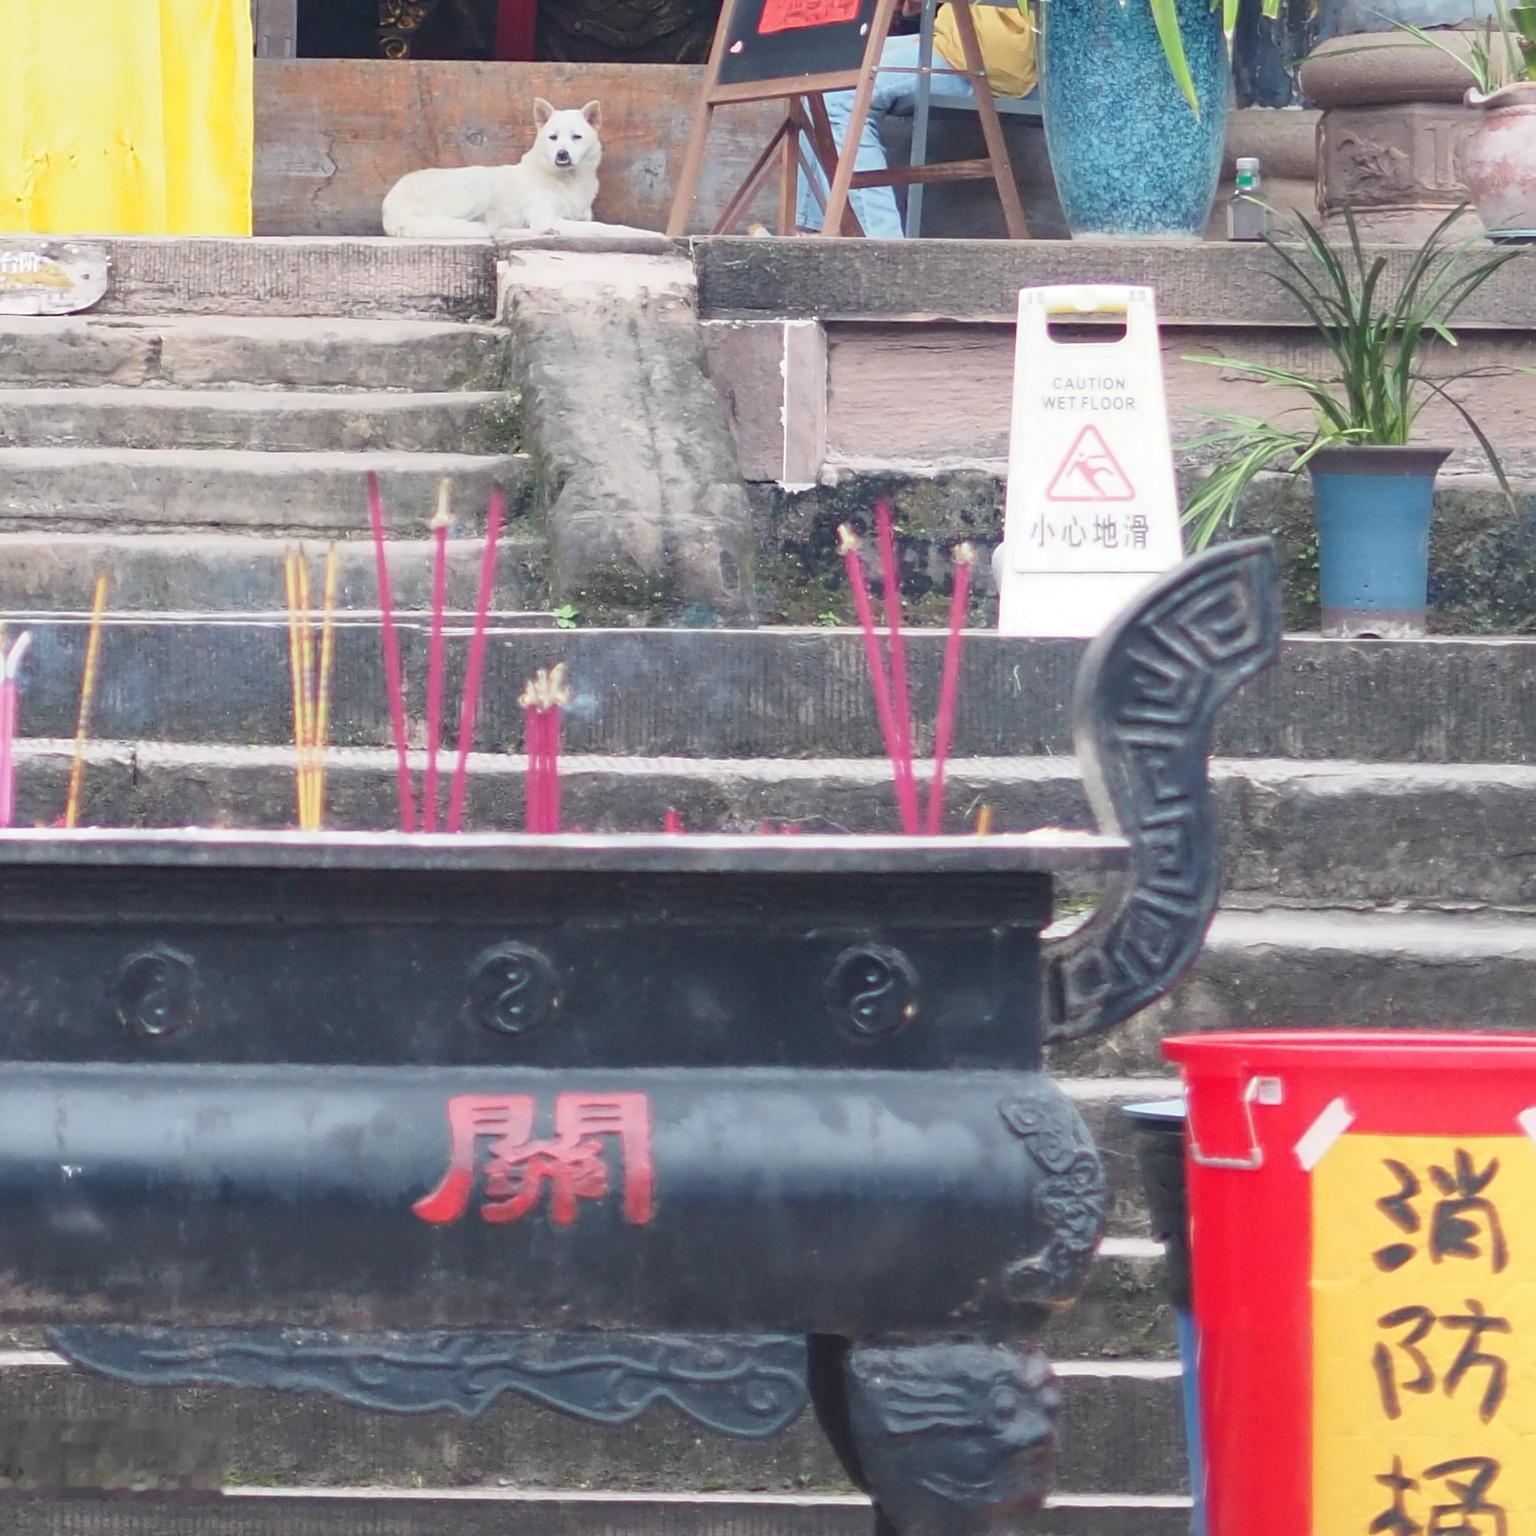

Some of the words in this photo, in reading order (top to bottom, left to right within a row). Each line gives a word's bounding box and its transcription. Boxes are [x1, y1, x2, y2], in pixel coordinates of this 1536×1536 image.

[1052, 376, 1126, 390] CAUTION
[1042, 396, 1075, 410] WET
[1081, 396, 1135, 410] FLOOR
[1030, 513, 1149, 550] 小心地滑
